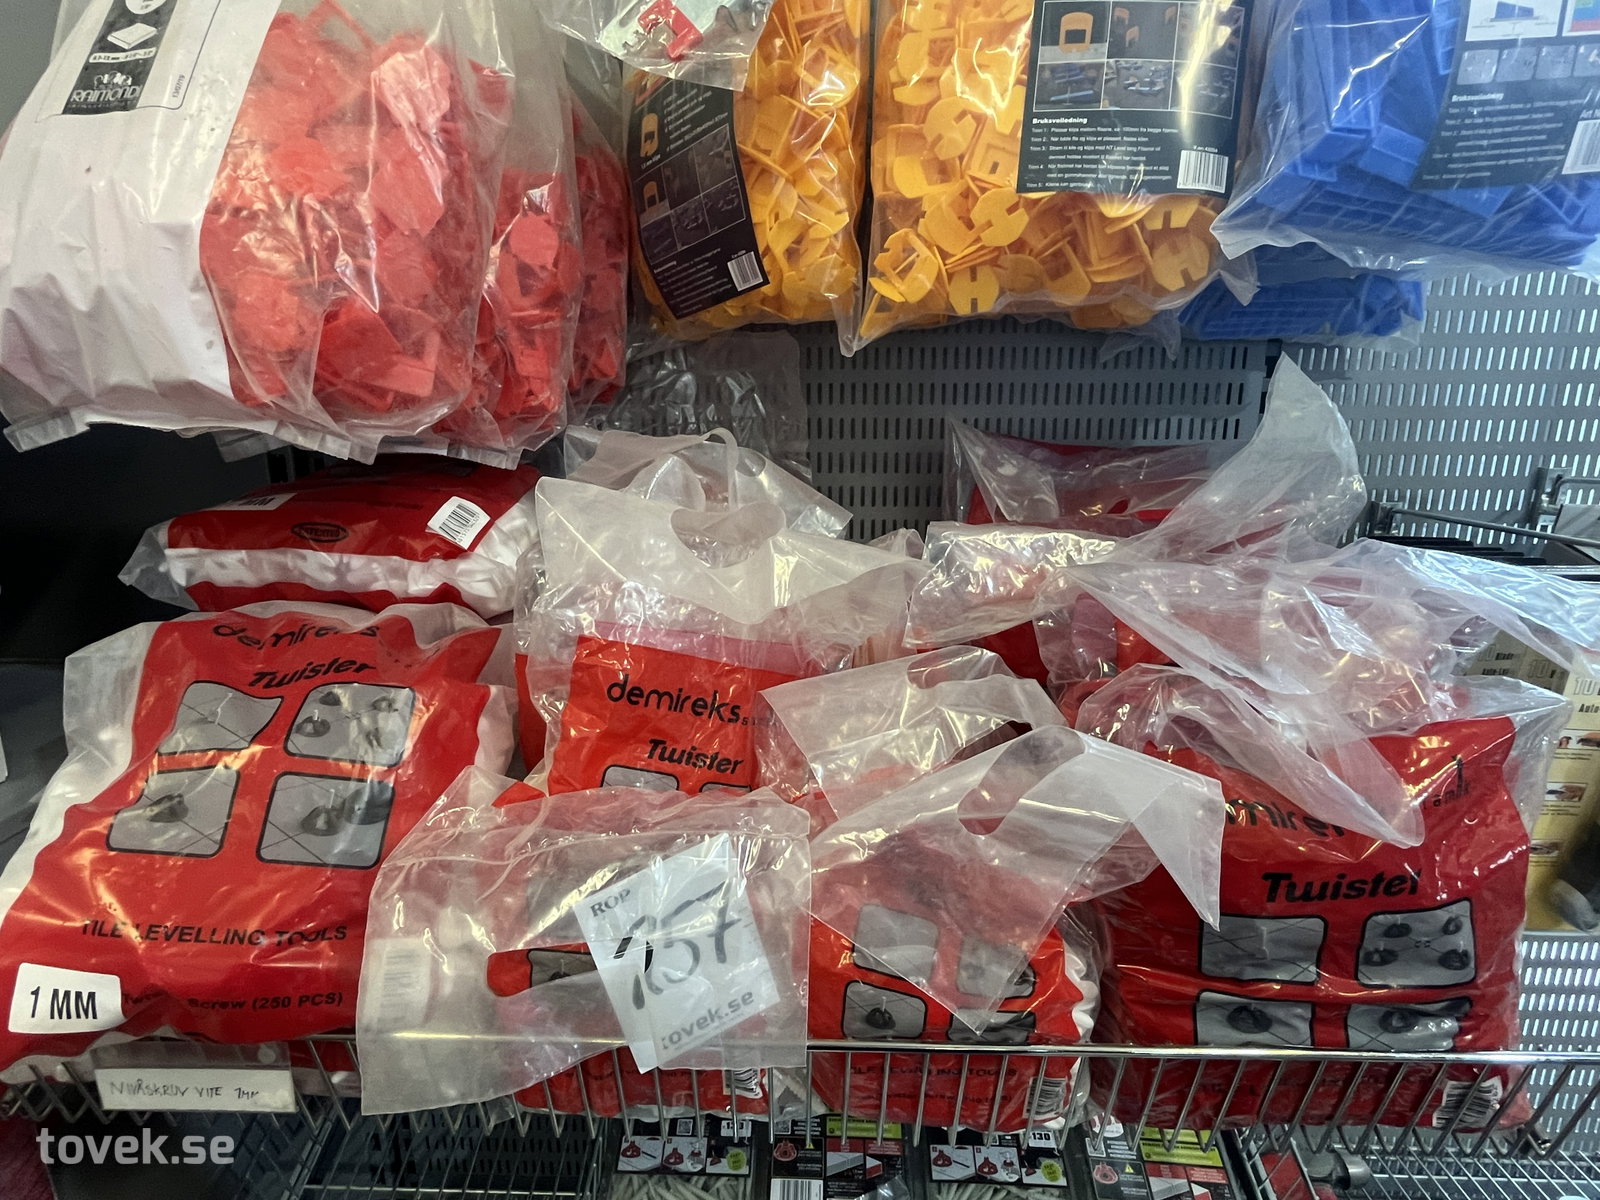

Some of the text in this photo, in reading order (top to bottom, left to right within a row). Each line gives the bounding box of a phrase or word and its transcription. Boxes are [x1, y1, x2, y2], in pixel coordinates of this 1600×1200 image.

[248, 657, 377, 689] Twister
[606, 674, 742, 724] demireks
[648, 738, 744, 774] Twister
[590, 888, 631, 917] ROP
[30, 986, 41, 1018] 1
[50, 988, 99, 1020] MM
[297, 992, 344, 1007] PCS)
[1031, 1132, 1051, 1141] 130
